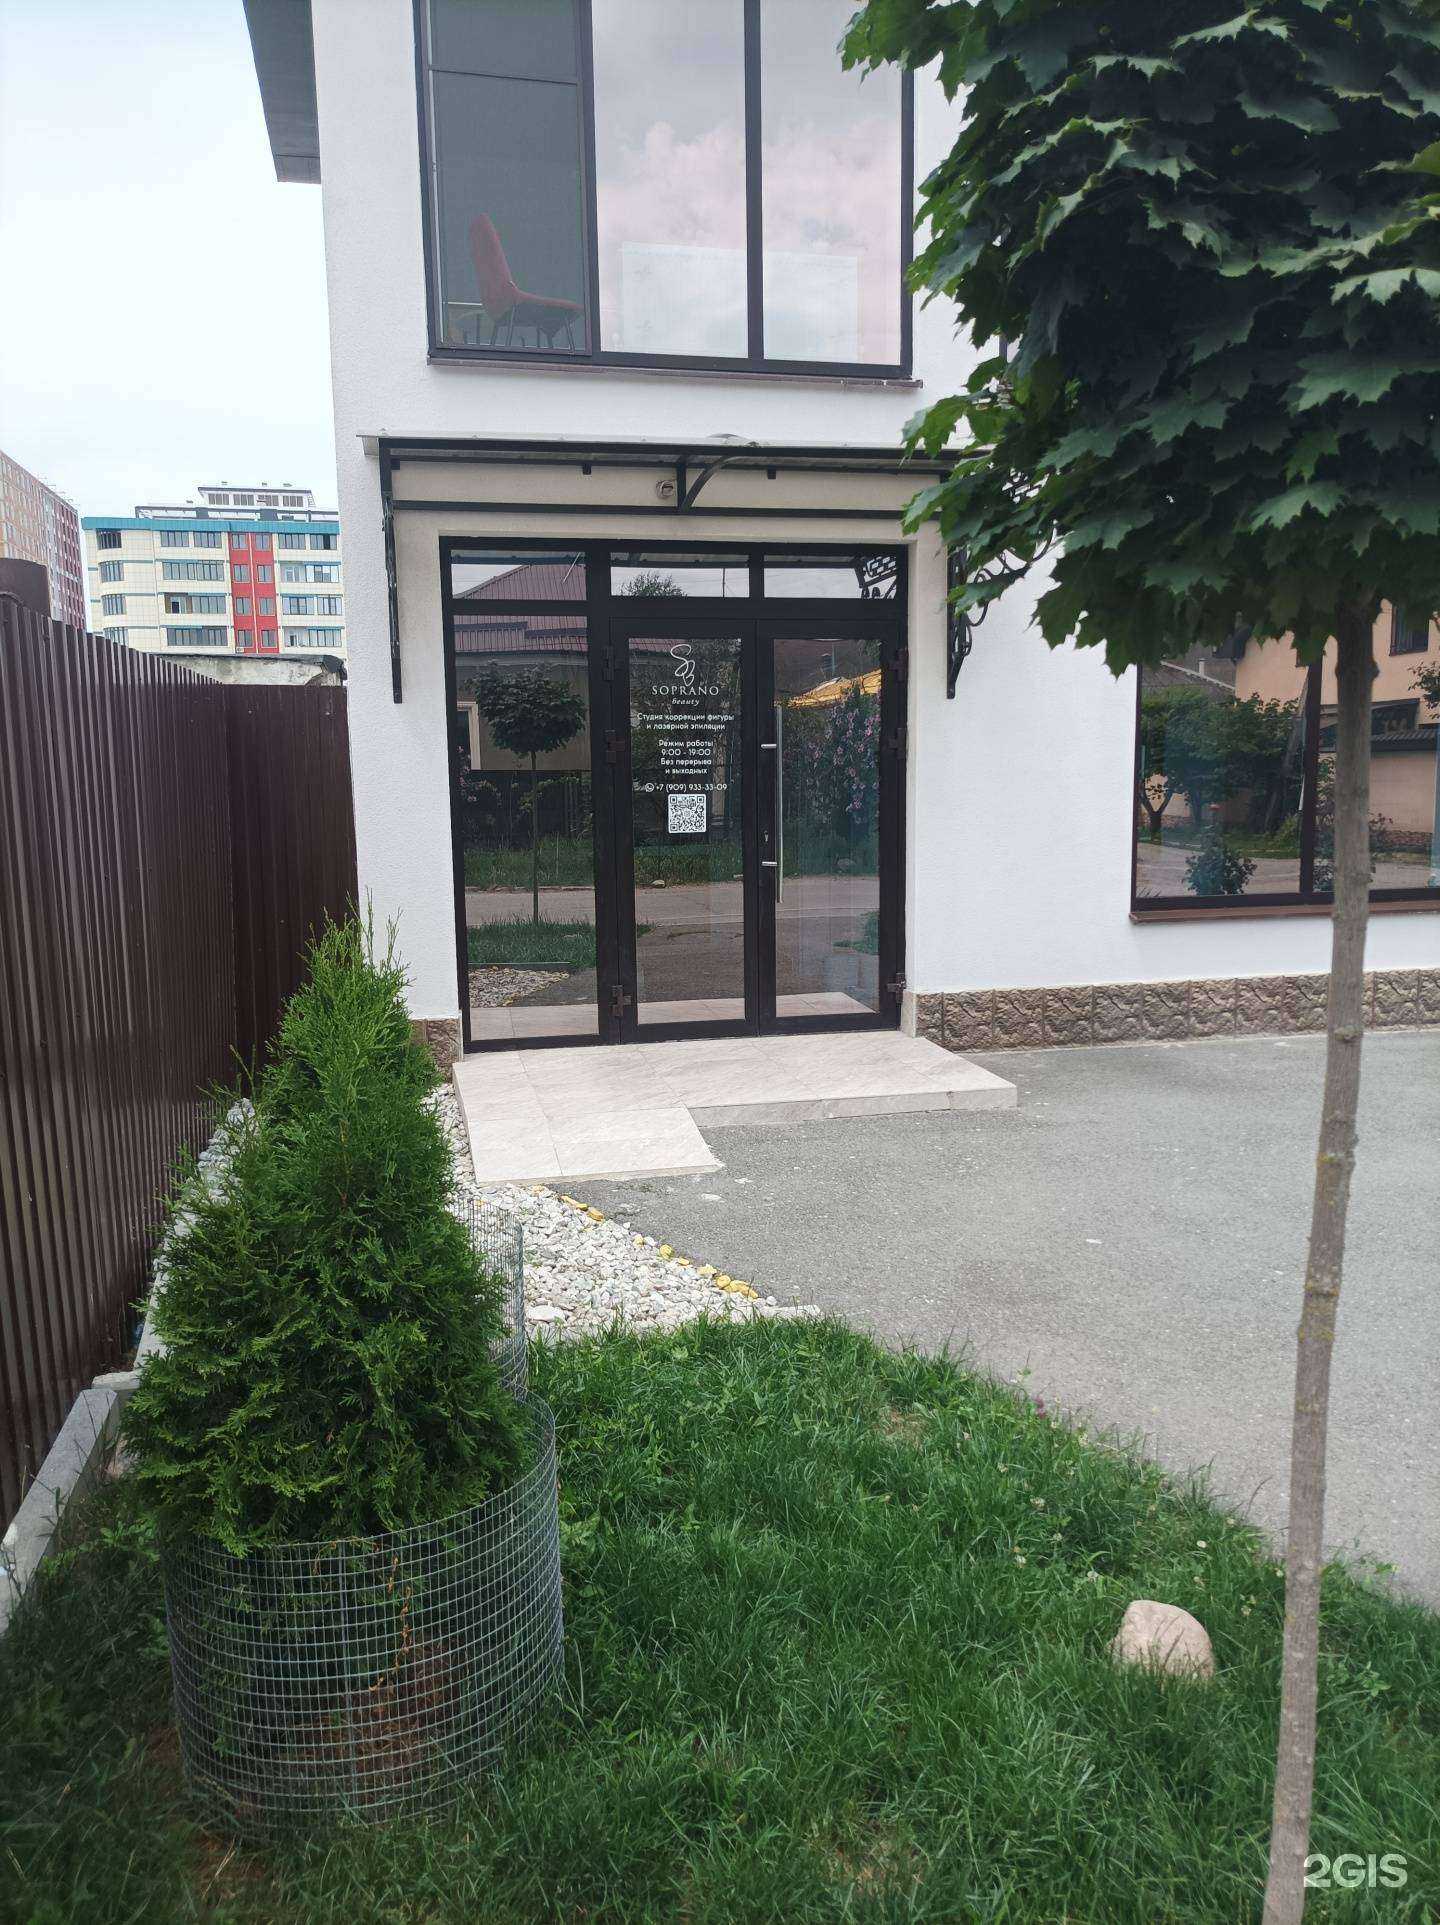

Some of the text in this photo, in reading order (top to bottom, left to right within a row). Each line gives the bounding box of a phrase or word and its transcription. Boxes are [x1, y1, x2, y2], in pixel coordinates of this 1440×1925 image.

[651, 685, 719, 696] SOPRANO
[671, 697, 700, 707] beauty
[637, 713, 663, 721] Студия
[653, 723, 689, 731] лазерной
[690, 724, 726, 732] эпиляции
[658, 739, 714, 748] Режим работы
[661, 748, 681, 756] 9:00
[688, 748, 711, 756] 19:00
[660, 757, 712, 767] Без перерыва
[656, 783, 728, 793] +7 (909) 933-33-09
